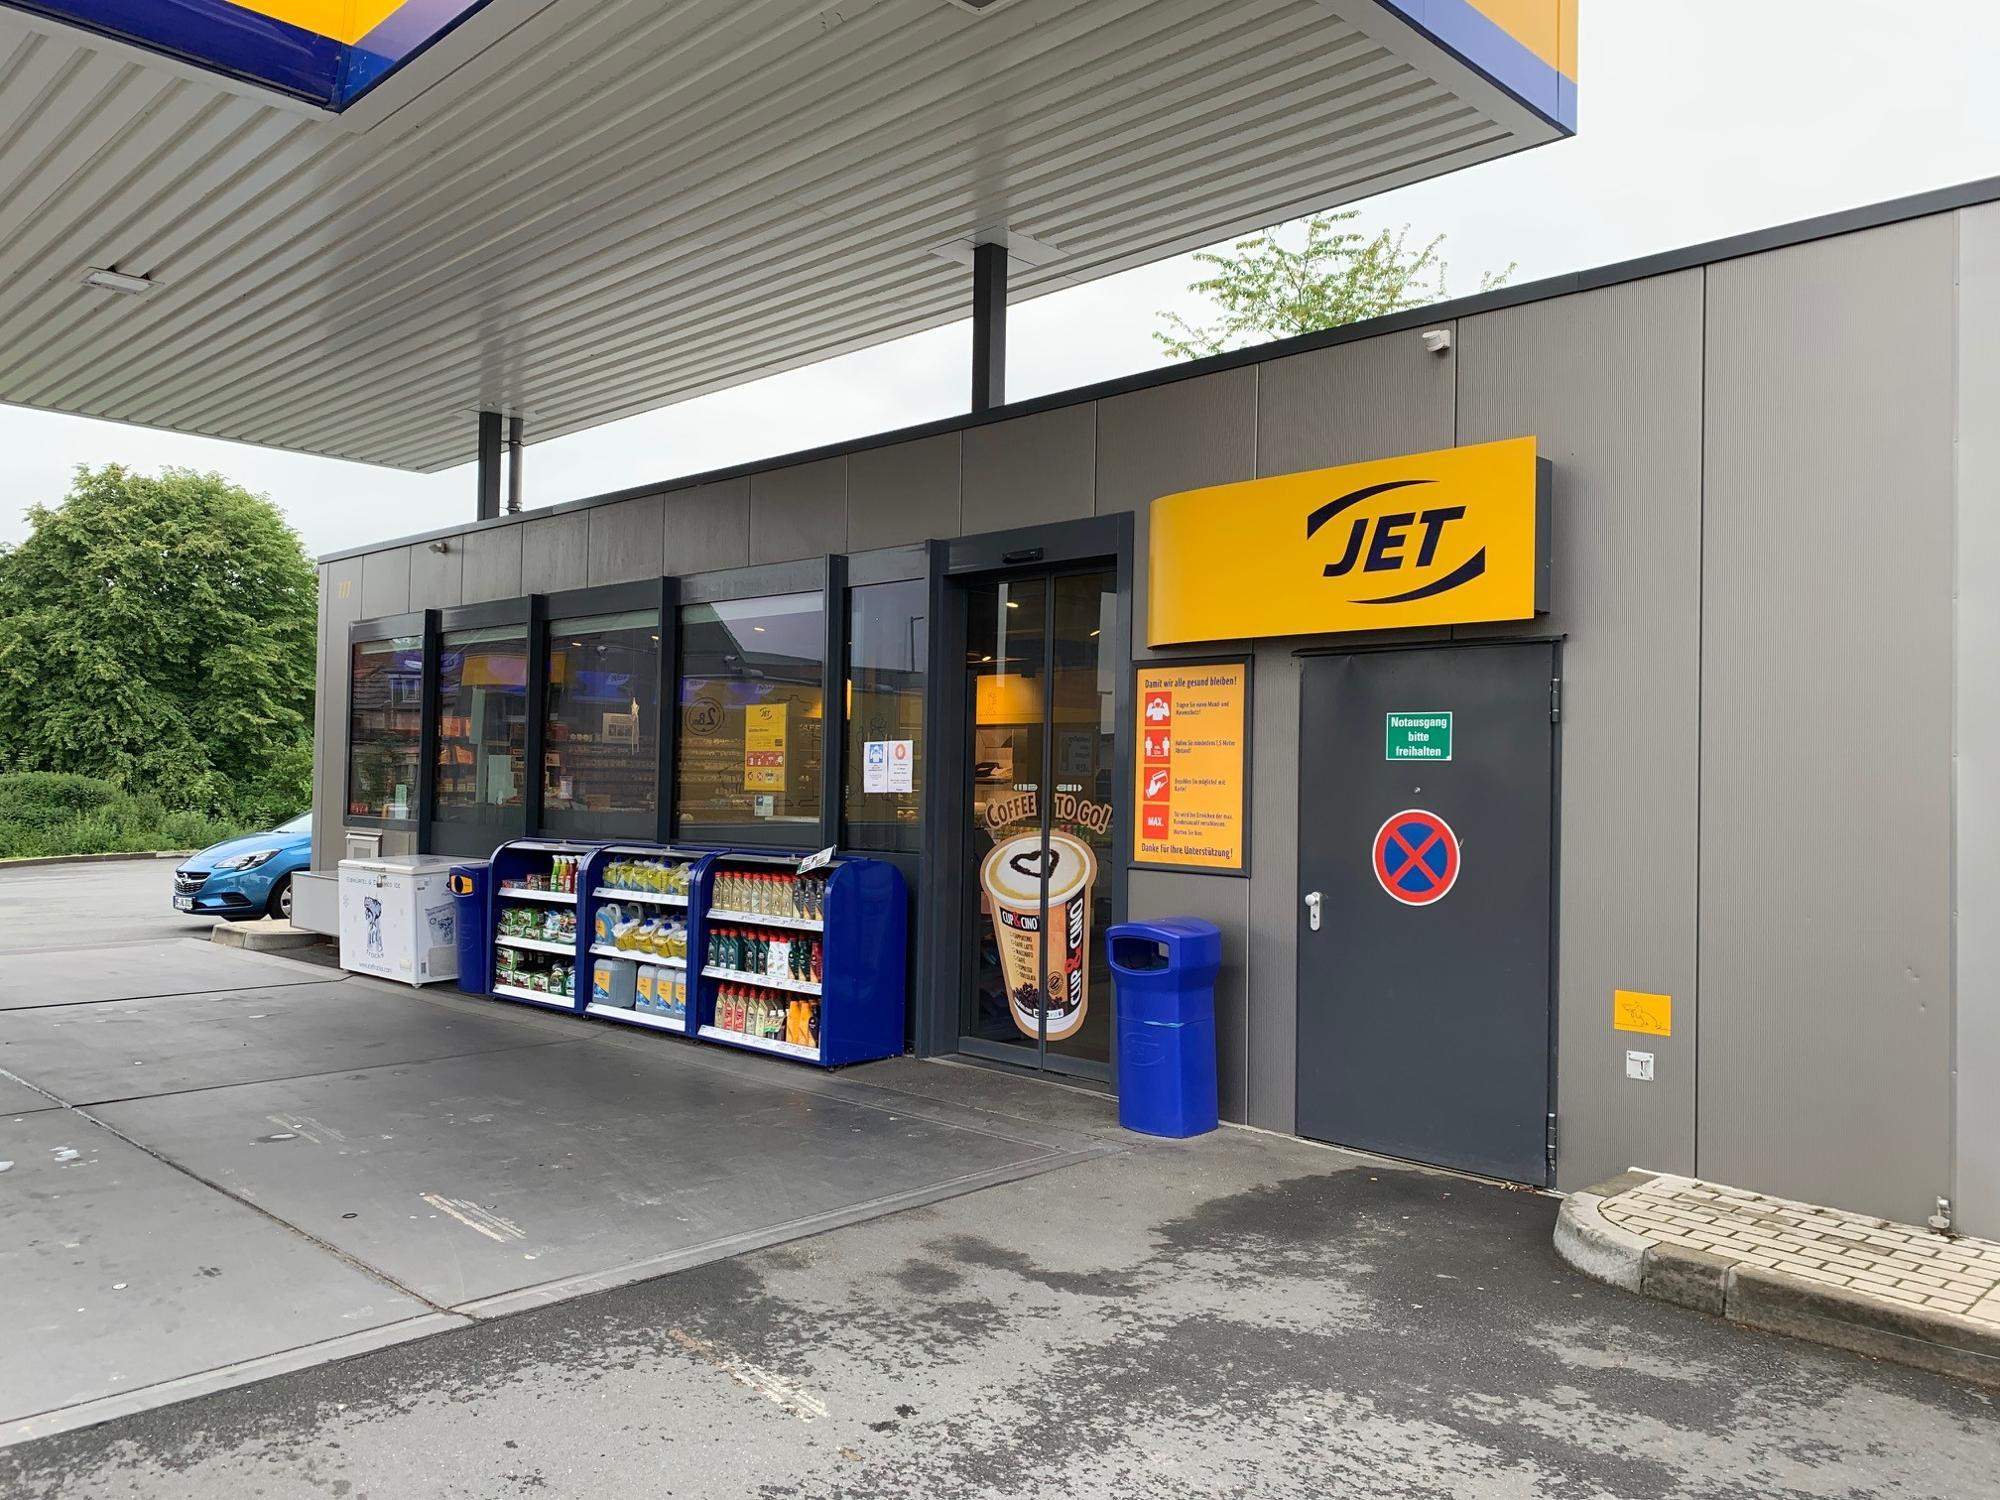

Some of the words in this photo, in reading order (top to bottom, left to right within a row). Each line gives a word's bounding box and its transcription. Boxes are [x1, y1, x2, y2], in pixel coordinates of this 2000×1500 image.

[1322, 505, 1467, 577] JET
[1145, 679, 1163, 688] Damit
[1164, 679, 1173, 687] wir
[1174, 678, 1185, 687] alle
[1187, 677, 1208, 689] gesund
[1210, 676, 1237, 686] bleiben!
[1391, 716, 1447, 729] Notausgang
[1408, 731, 1430, 742] bitte
[1395, 745, 1441, 756] freihalten
[986, 795, 1036, 827] COFFEE
[1056, 796, 1075, 817] TO
[1079, 802, 1110, 832] GO!
[1147, 816, 1164, 827] MAX.
[1141, 843, 1159, 853] Danke
[1161, 843, 1170, 853] für
[1170, 844, 1182, 854] Ihre
[1184, 846, 1233, 860] Unterstützung!
